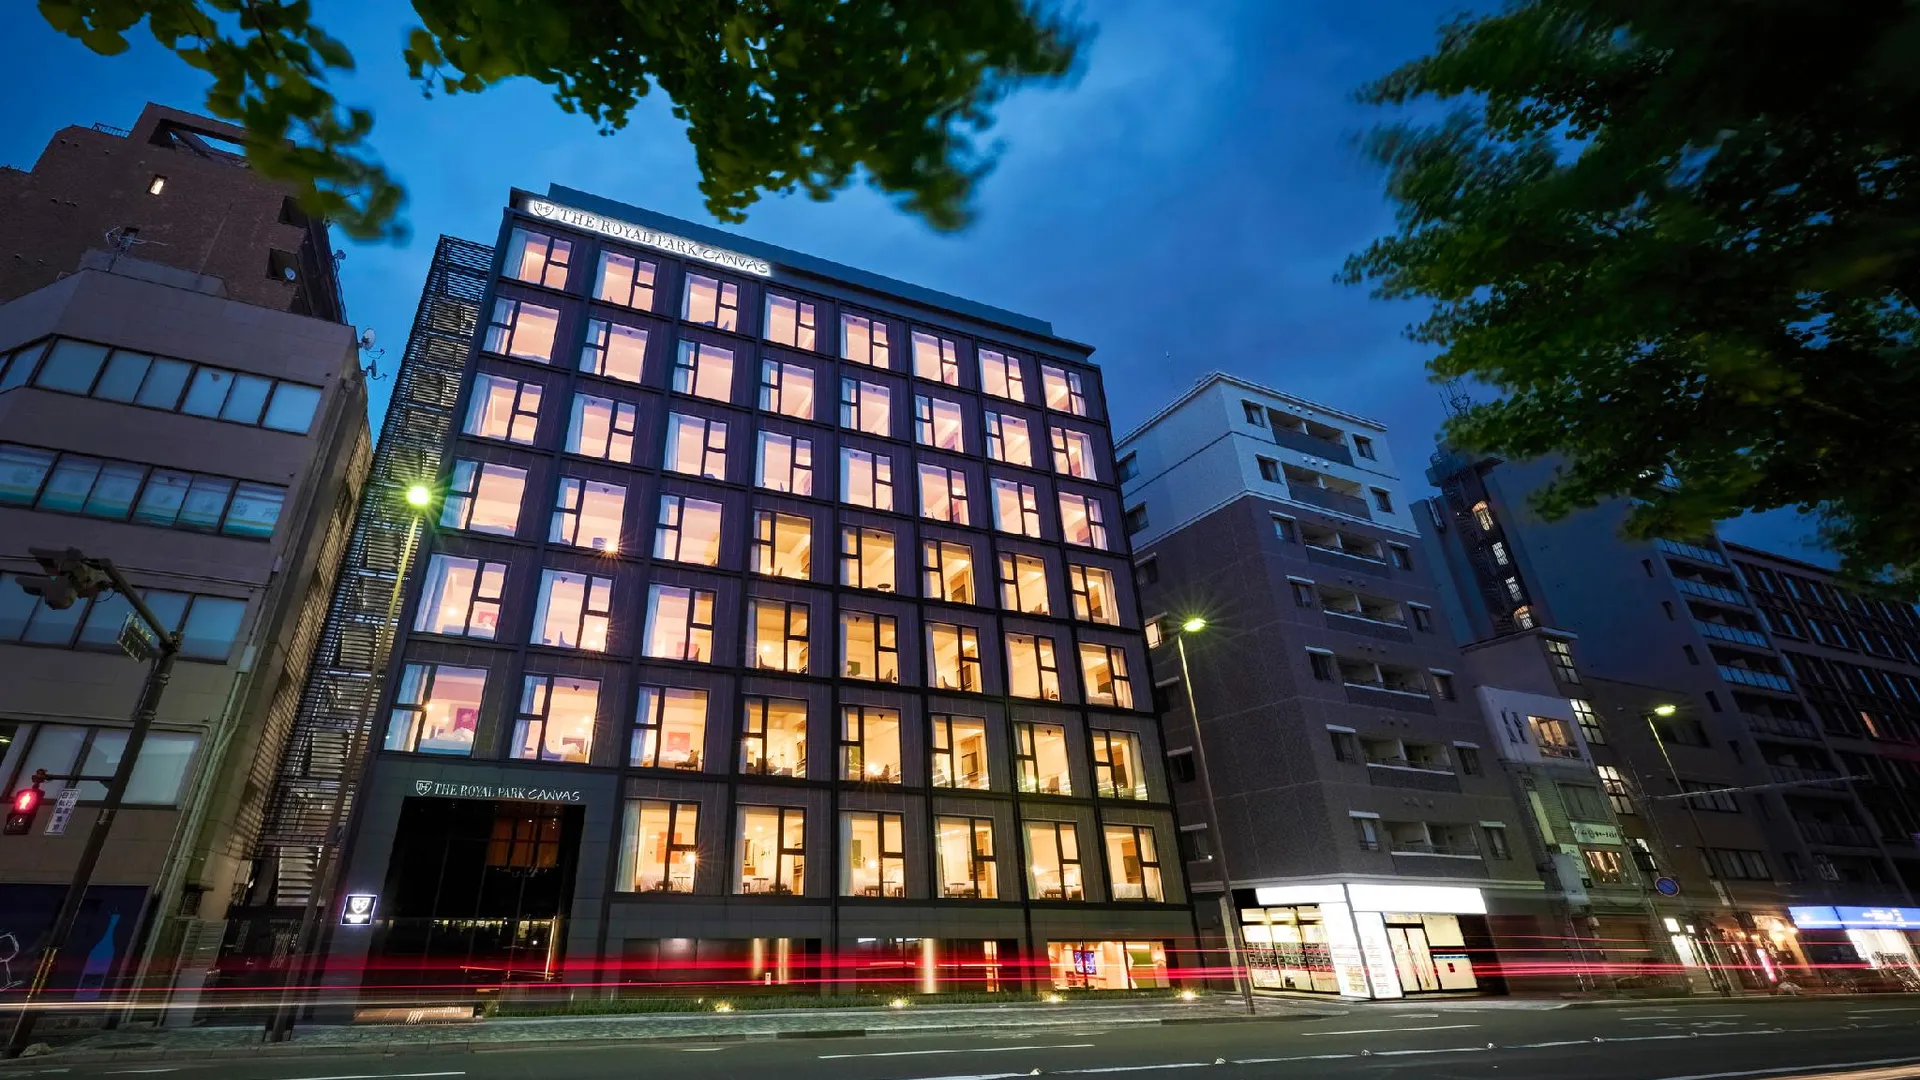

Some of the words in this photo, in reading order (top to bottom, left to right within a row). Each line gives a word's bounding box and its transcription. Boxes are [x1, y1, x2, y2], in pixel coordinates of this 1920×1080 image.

[560, 208, 595, 229] THE
[601, 219, 651, 243] ROYAL
[656, 234, 698, 256] PARK
[703, 249, 768, 274] CANVAS
[434, 783, 458, 796] THE
[460, 785, 495, 798] ROYAL
[498, 787, 526, 799] PARK
[528, 788, 580, 801] CANVAS
